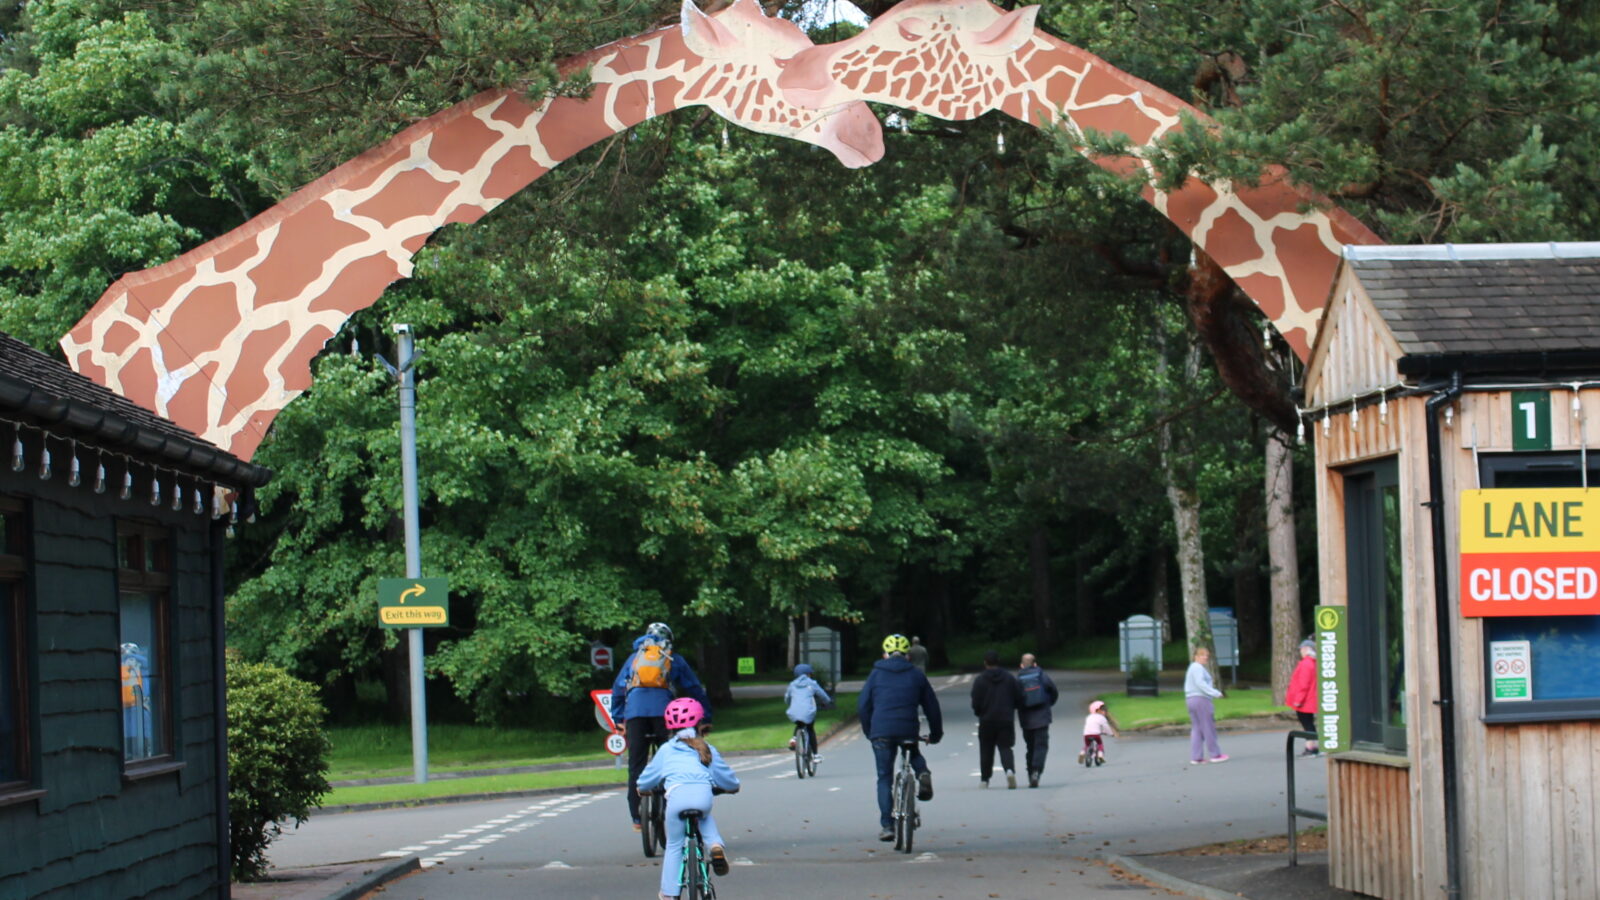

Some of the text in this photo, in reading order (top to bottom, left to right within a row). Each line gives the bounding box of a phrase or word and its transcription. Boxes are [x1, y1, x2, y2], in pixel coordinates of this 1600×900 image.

[1519, 402, 1536, 439] 1
[1484, 502, 1583, 538] LANE
[1470, 567, 1597, 601] CLOSED
[385, 610, 404, 620] Exit
[405, 609, 422, 619] this
[1321, 632, 1340, 750] Please stop here
[610, 738, 622, 749] 15
